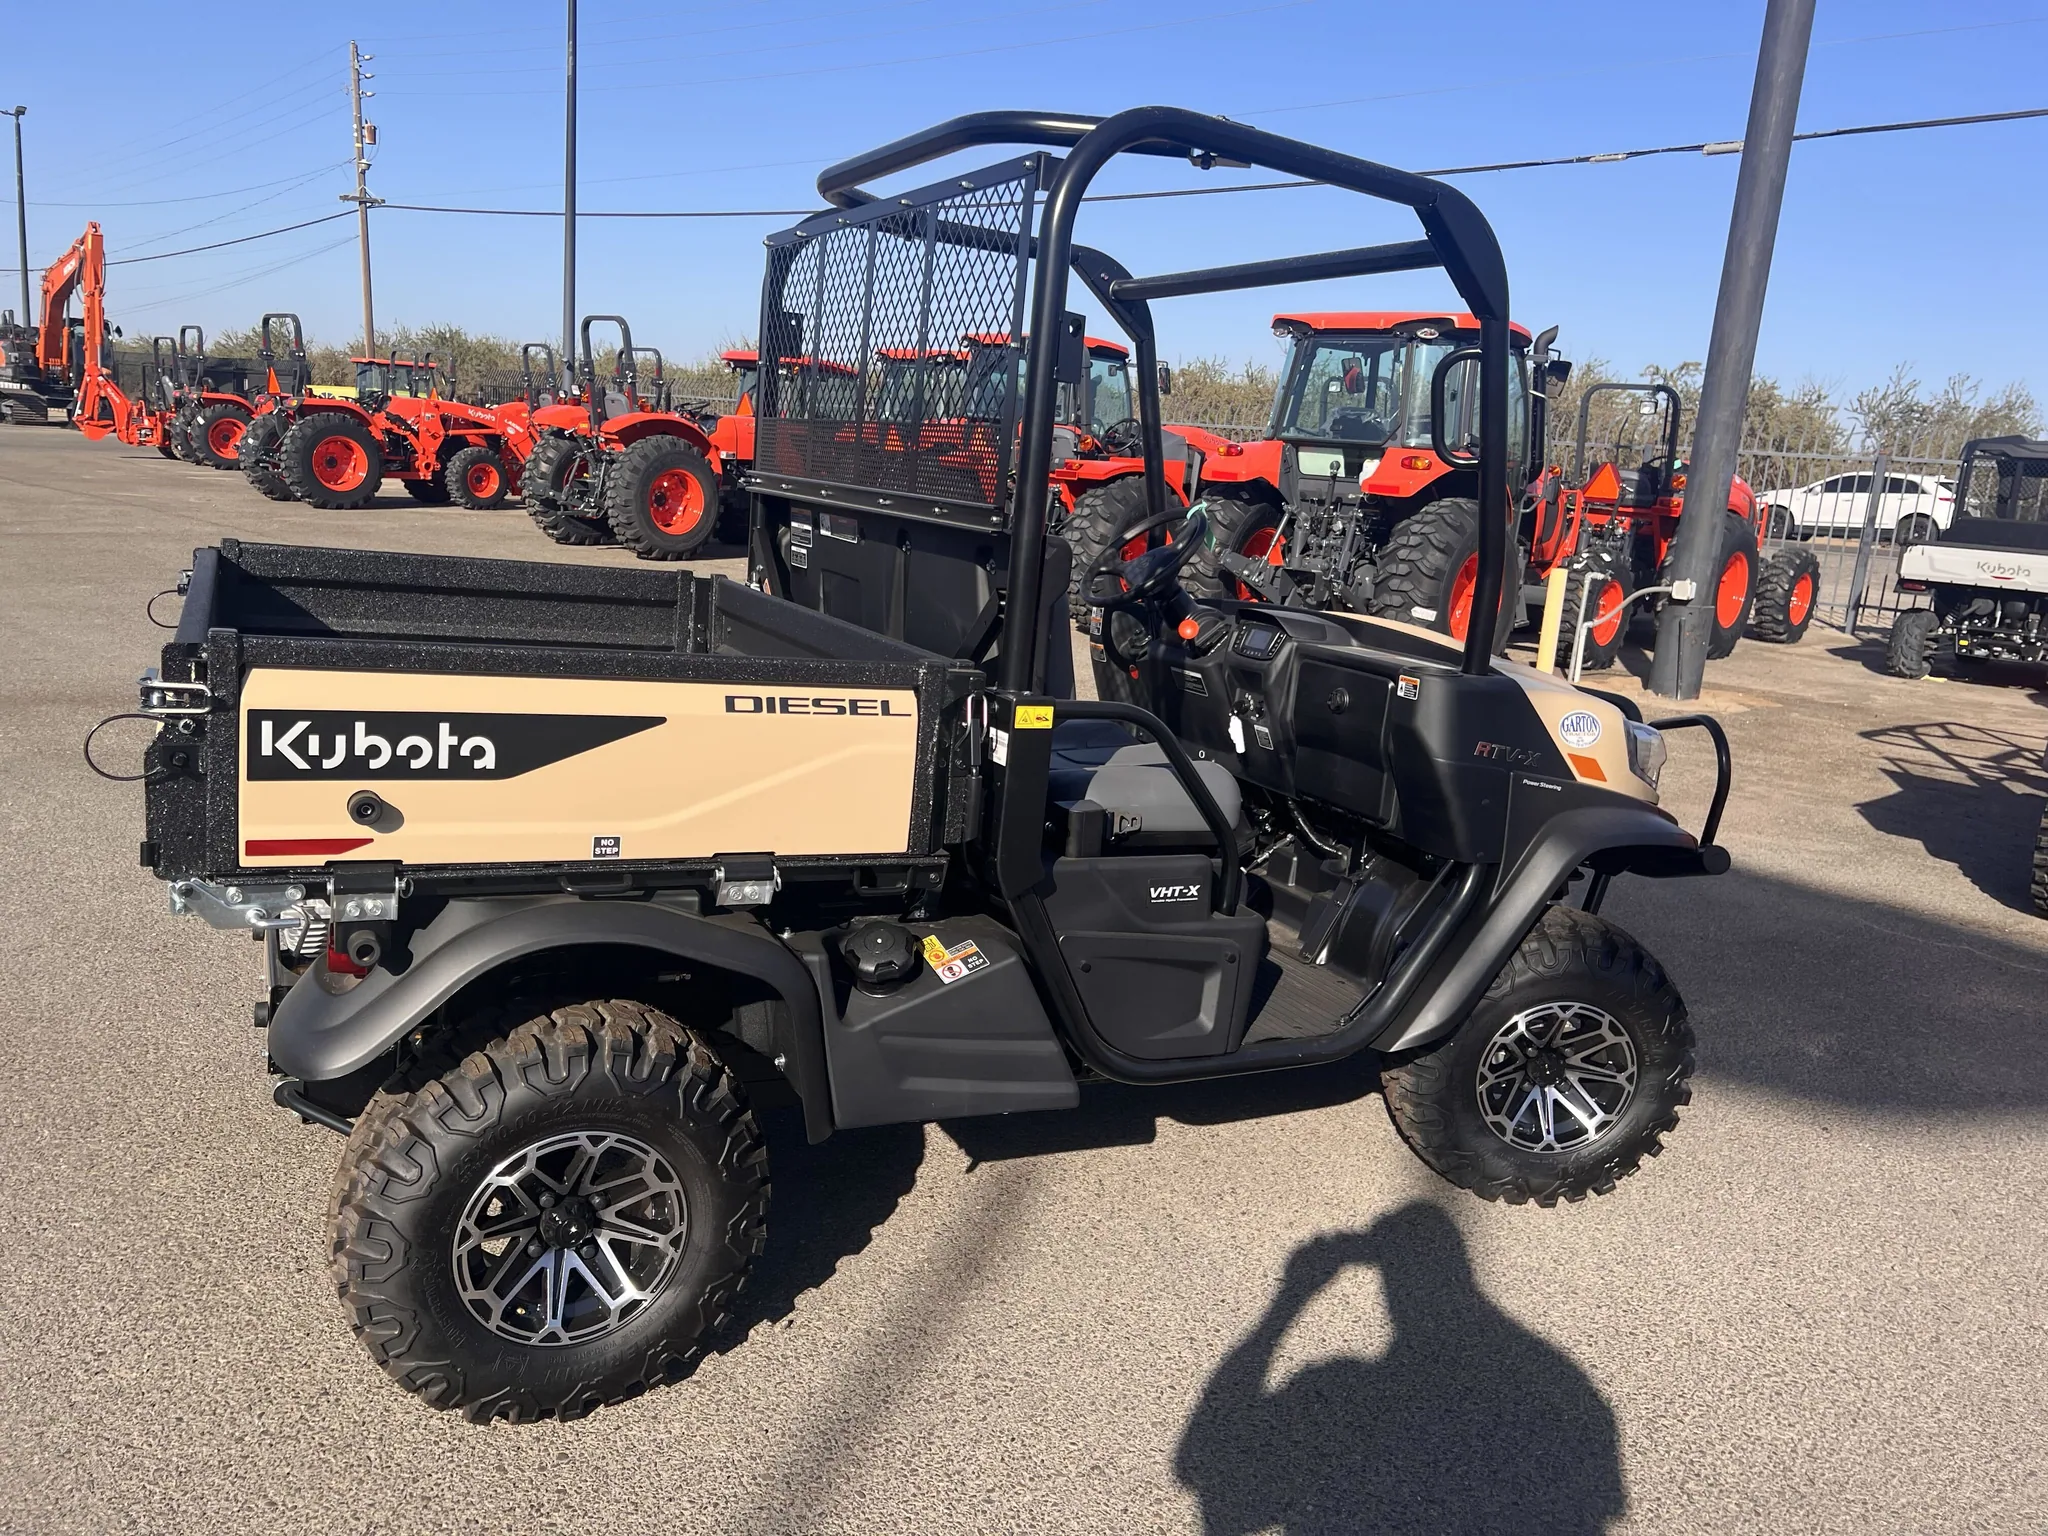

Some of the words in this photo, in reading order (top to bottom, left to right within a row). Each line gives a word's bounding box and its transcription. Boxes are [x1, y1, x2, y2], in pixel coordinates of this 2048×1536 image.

[468, 408, 496, 422] Kubota
[1977, 561, 2031, 577] Kubota
[725, 695, 912, 717] DIESEL
[1562, 715, 1598, 733] GARTON
[261, 720, 496, 770] Kubota
[1474, 741, 1541, 767] RTV-X
[1522, 779, 1539, 788] Power
[1539, 782, 1562, 792] Steering
[594, 847, 619, 855] STEP
[1150, 885, 1201, 898] VHT-X
[967, 955, 978, 963] NO
[967, 958, 984, 969] STEP
